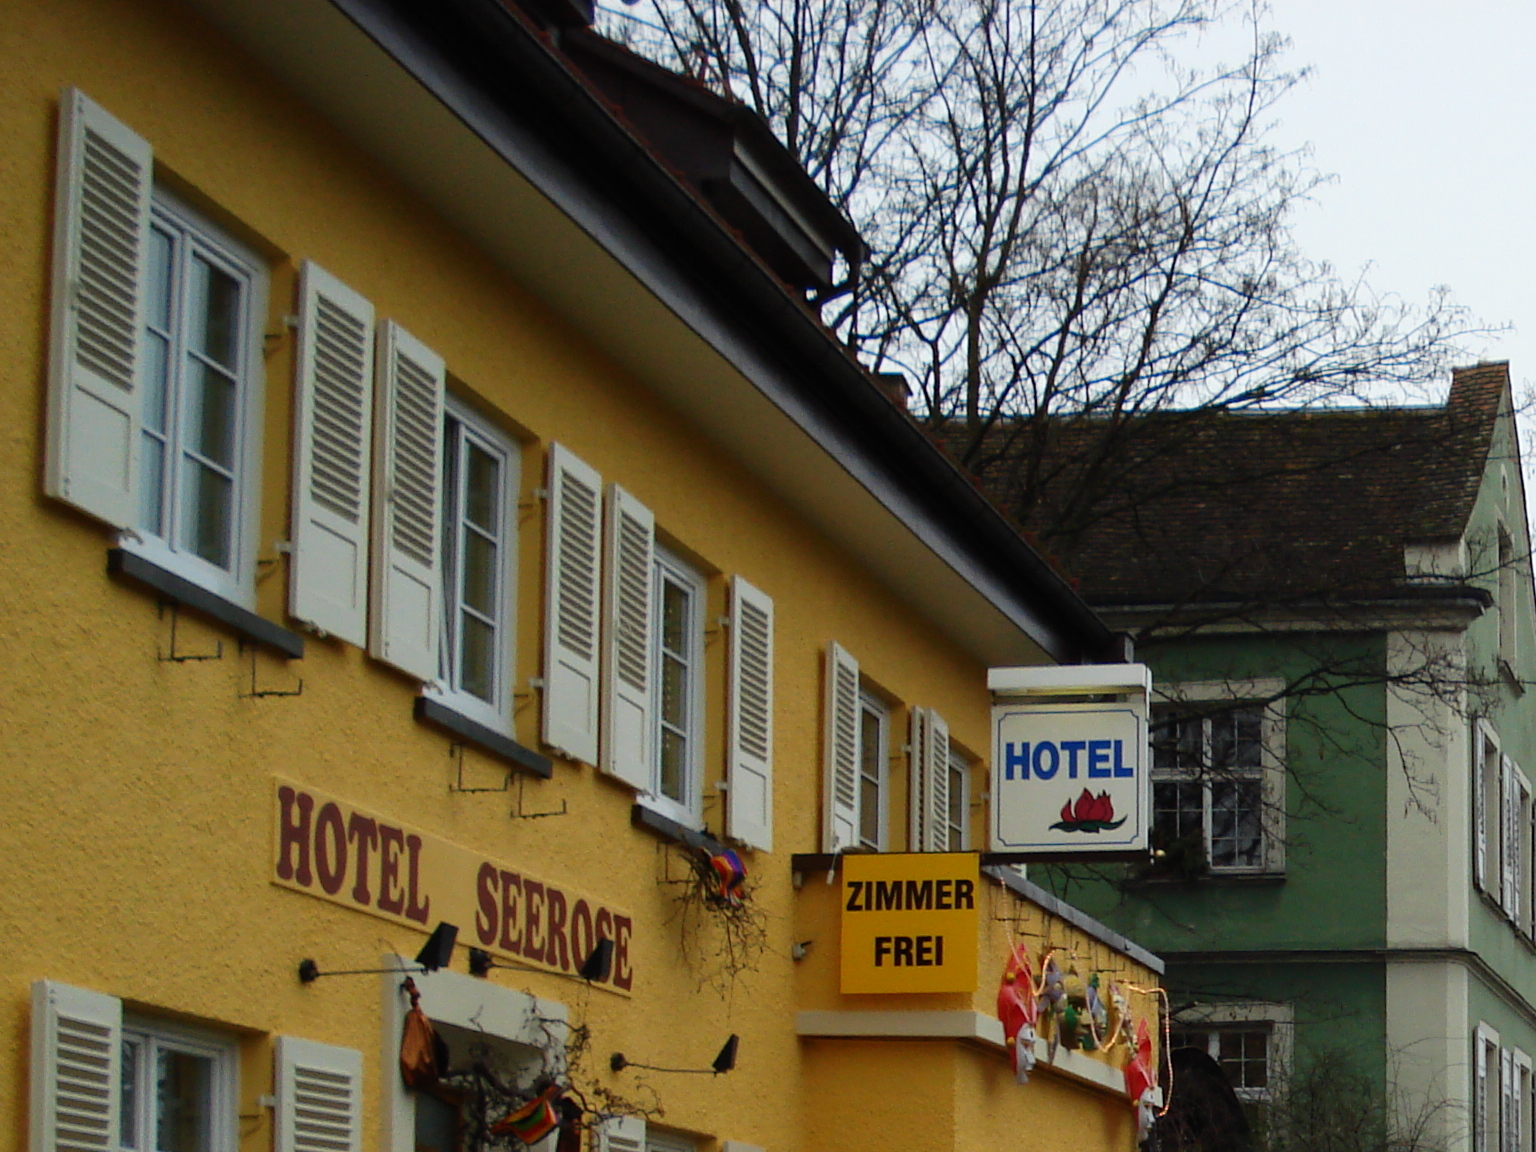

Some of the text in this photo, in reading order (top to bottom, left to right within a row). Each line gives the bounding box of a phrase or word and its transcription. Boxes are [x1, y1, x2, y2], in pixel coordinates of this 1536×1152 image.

[1004, 739, 1134, 780] HOTEL
[276, 785, 633, 992] HOTEL SEEROSE
[846, 879, 975, 912] ZIMMER
[874, 934, 943, 967] FREI
